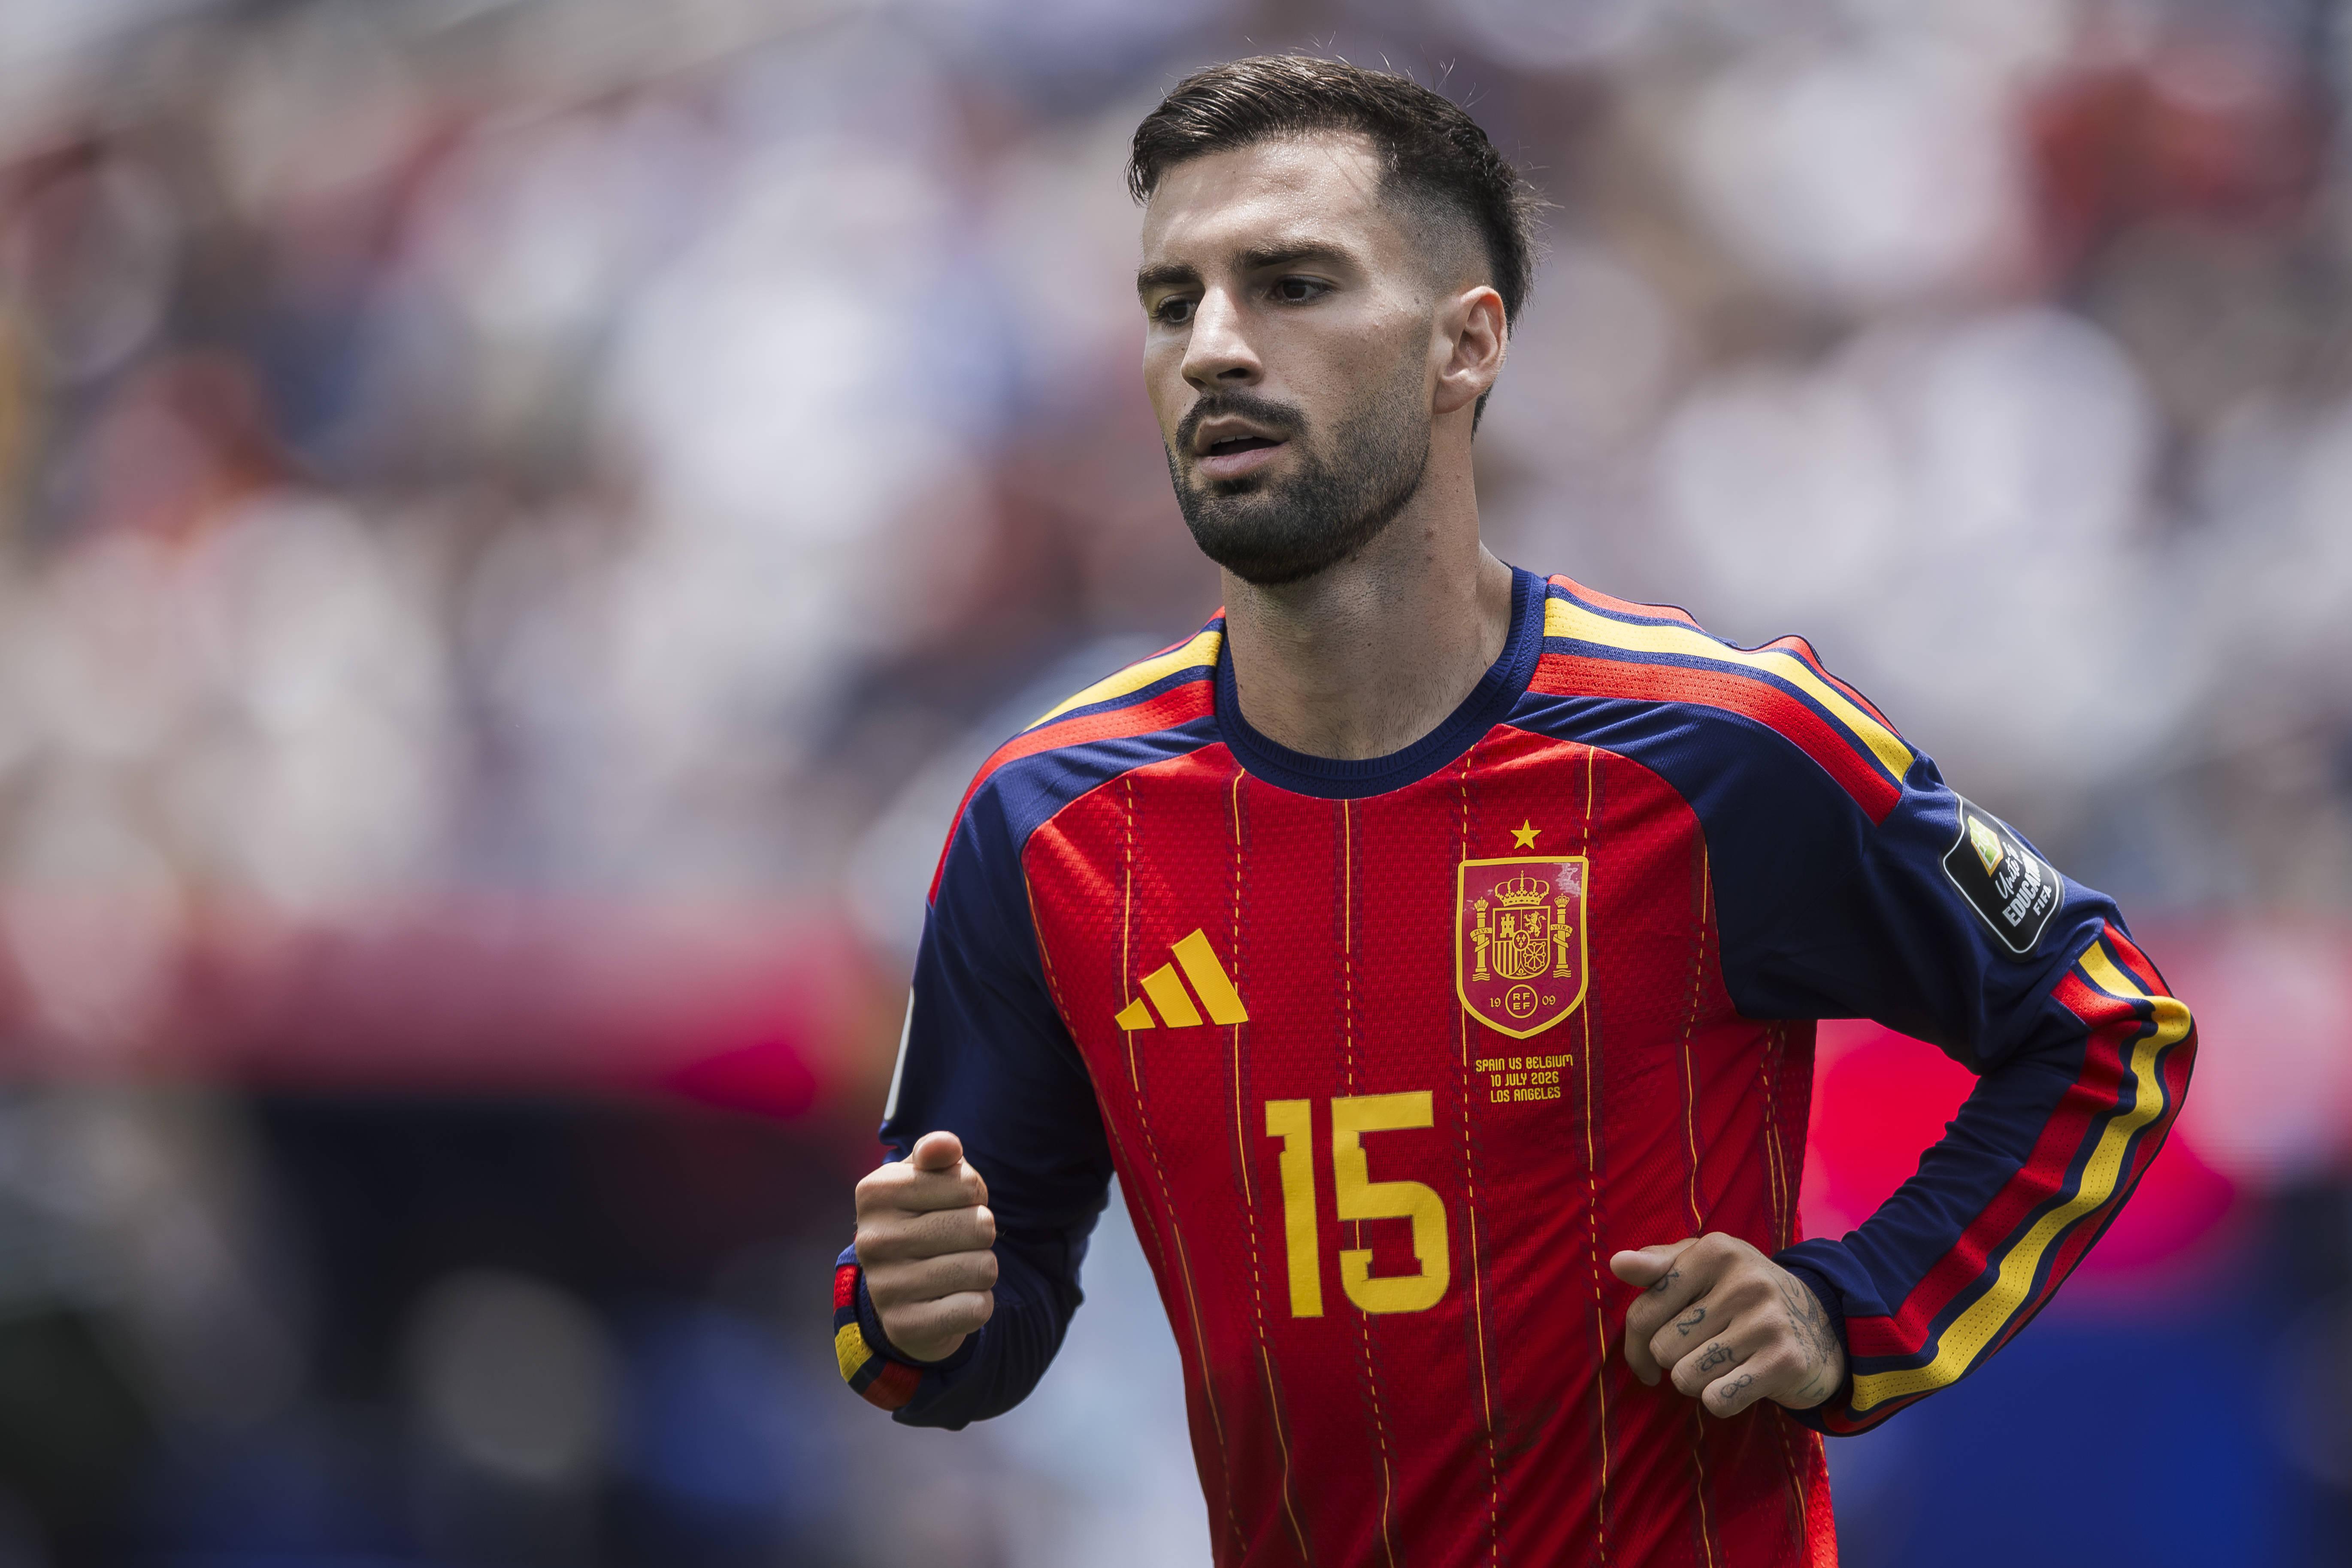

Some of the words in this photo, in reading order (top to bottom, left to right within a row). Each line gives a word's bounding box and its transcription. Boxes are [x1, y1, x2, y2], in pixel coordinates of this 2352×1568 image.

[1995, 857, 2020, 899] Unite
[2033, 885, 2052, 916] FIFA
[1490, 997, 1501, 1008] 19
[1542, 995, 1556, 1005] 09
[1476, 1058, 1505, 1072] SPAIN
[1509, 1057, 1522, 1070] VS
[1526, 1054, 1574, 1069] BELGIUM
[1490, 1074, 1501, 1087] 10
[1505, 1072, 1527, 1086] JULY
[1531, 1071, 1559, 1085] 2026
[1490, 1090, 1510, 1103] LOS
[1514, 1086, 1561, 1102] ANGELES
[1265, 1090, 1450, 1318] 15
